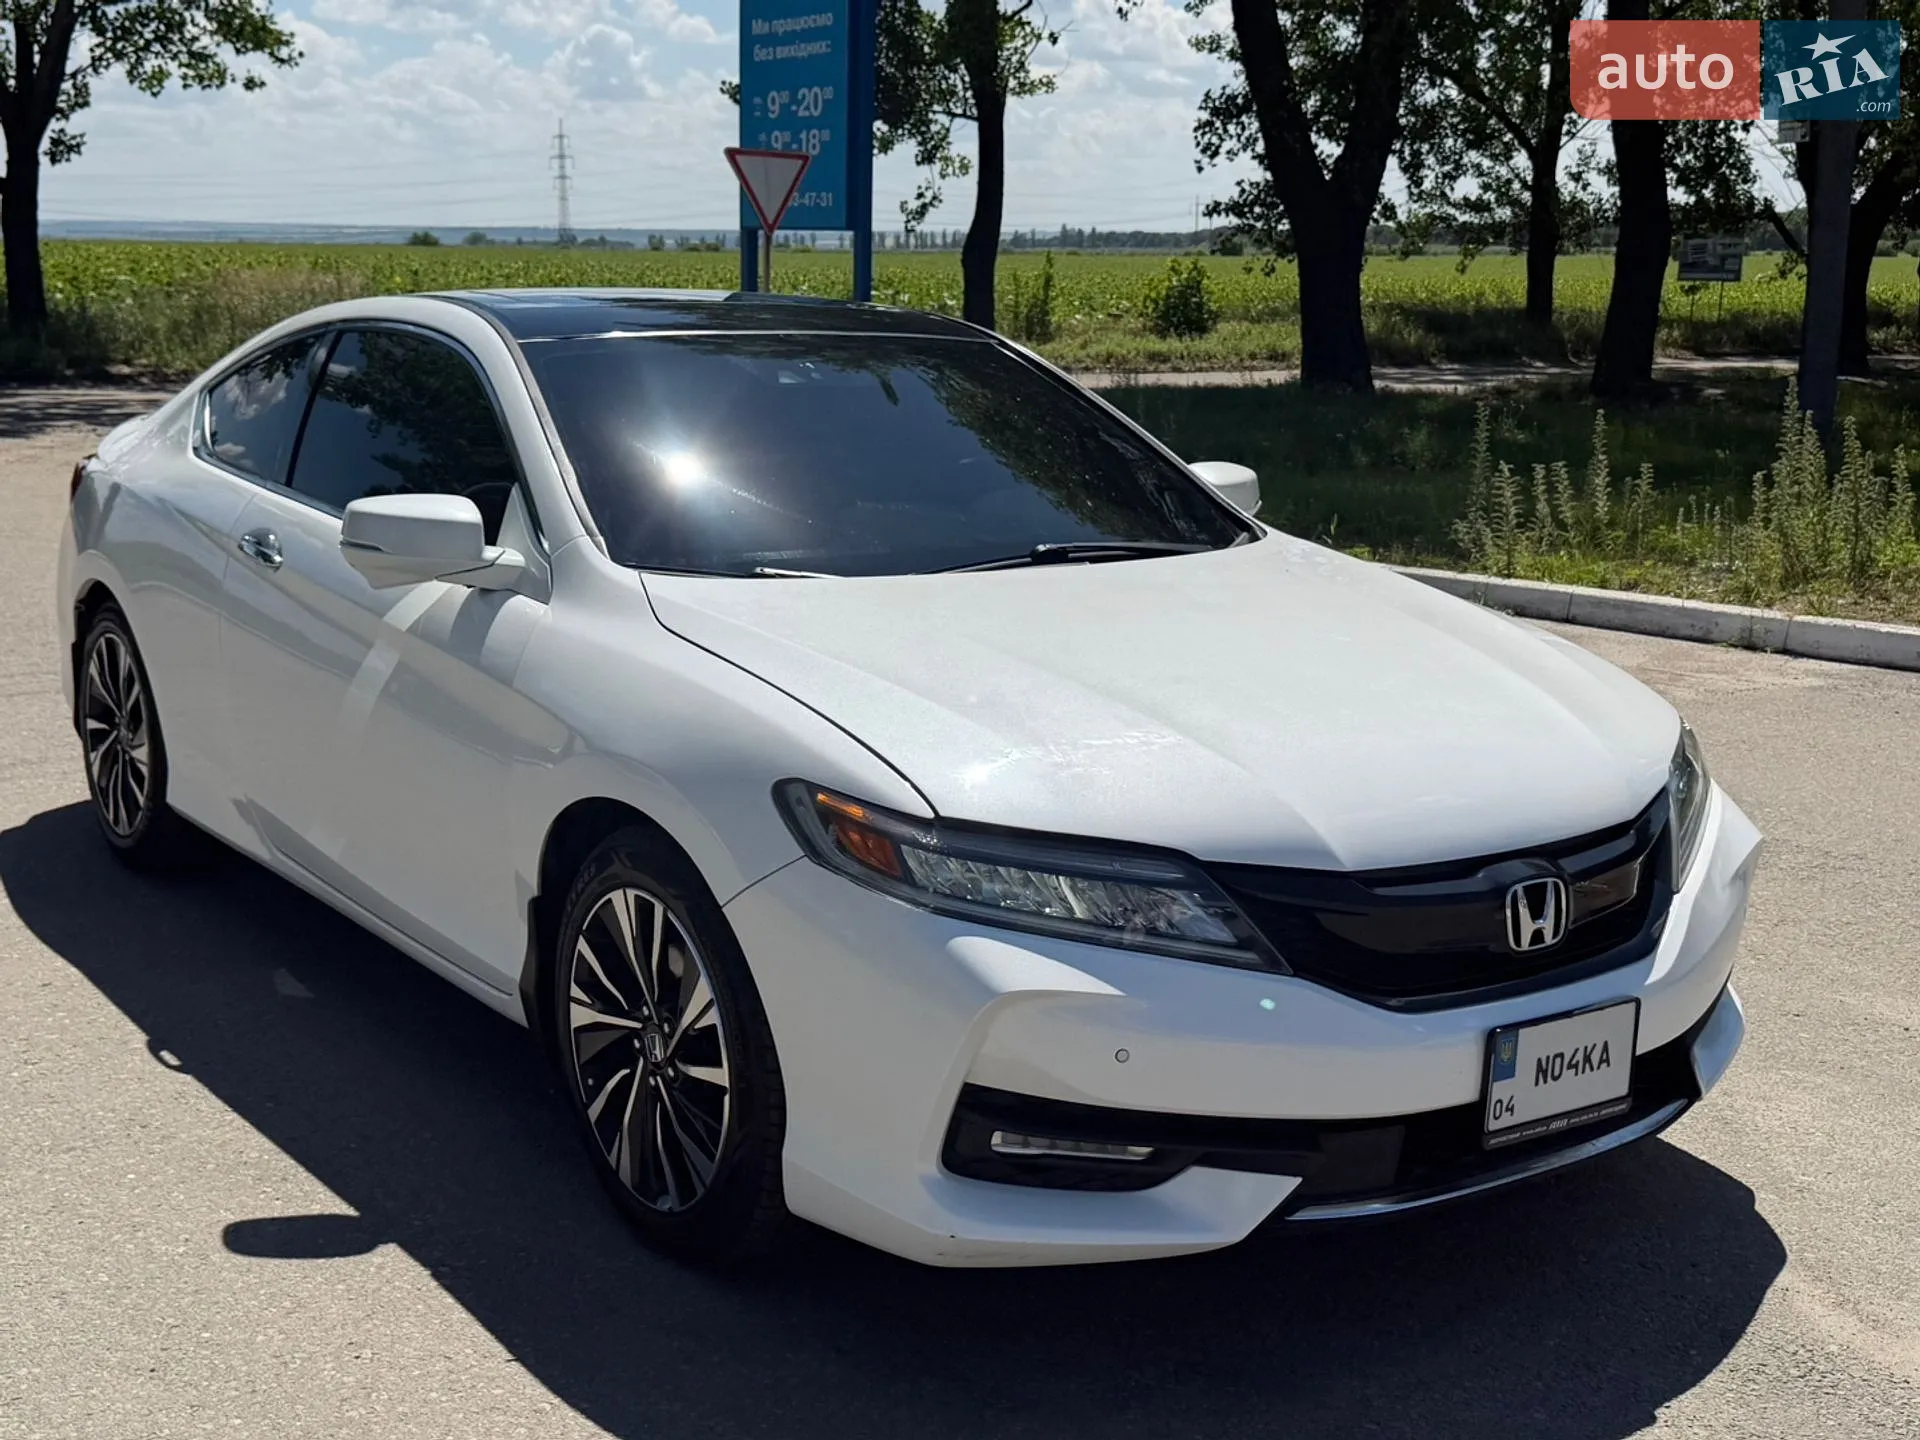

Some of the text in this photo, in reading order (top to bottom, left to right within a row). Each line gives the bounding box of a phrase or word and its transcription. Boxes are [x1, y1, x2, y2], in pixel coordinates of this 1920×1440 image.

[752, 18, 769, 35] Ми
[753, 44, 774, 61] без
[791, 191, 832, 207] 3-47-31
[1493, 1095, 1515, 1120] 04
